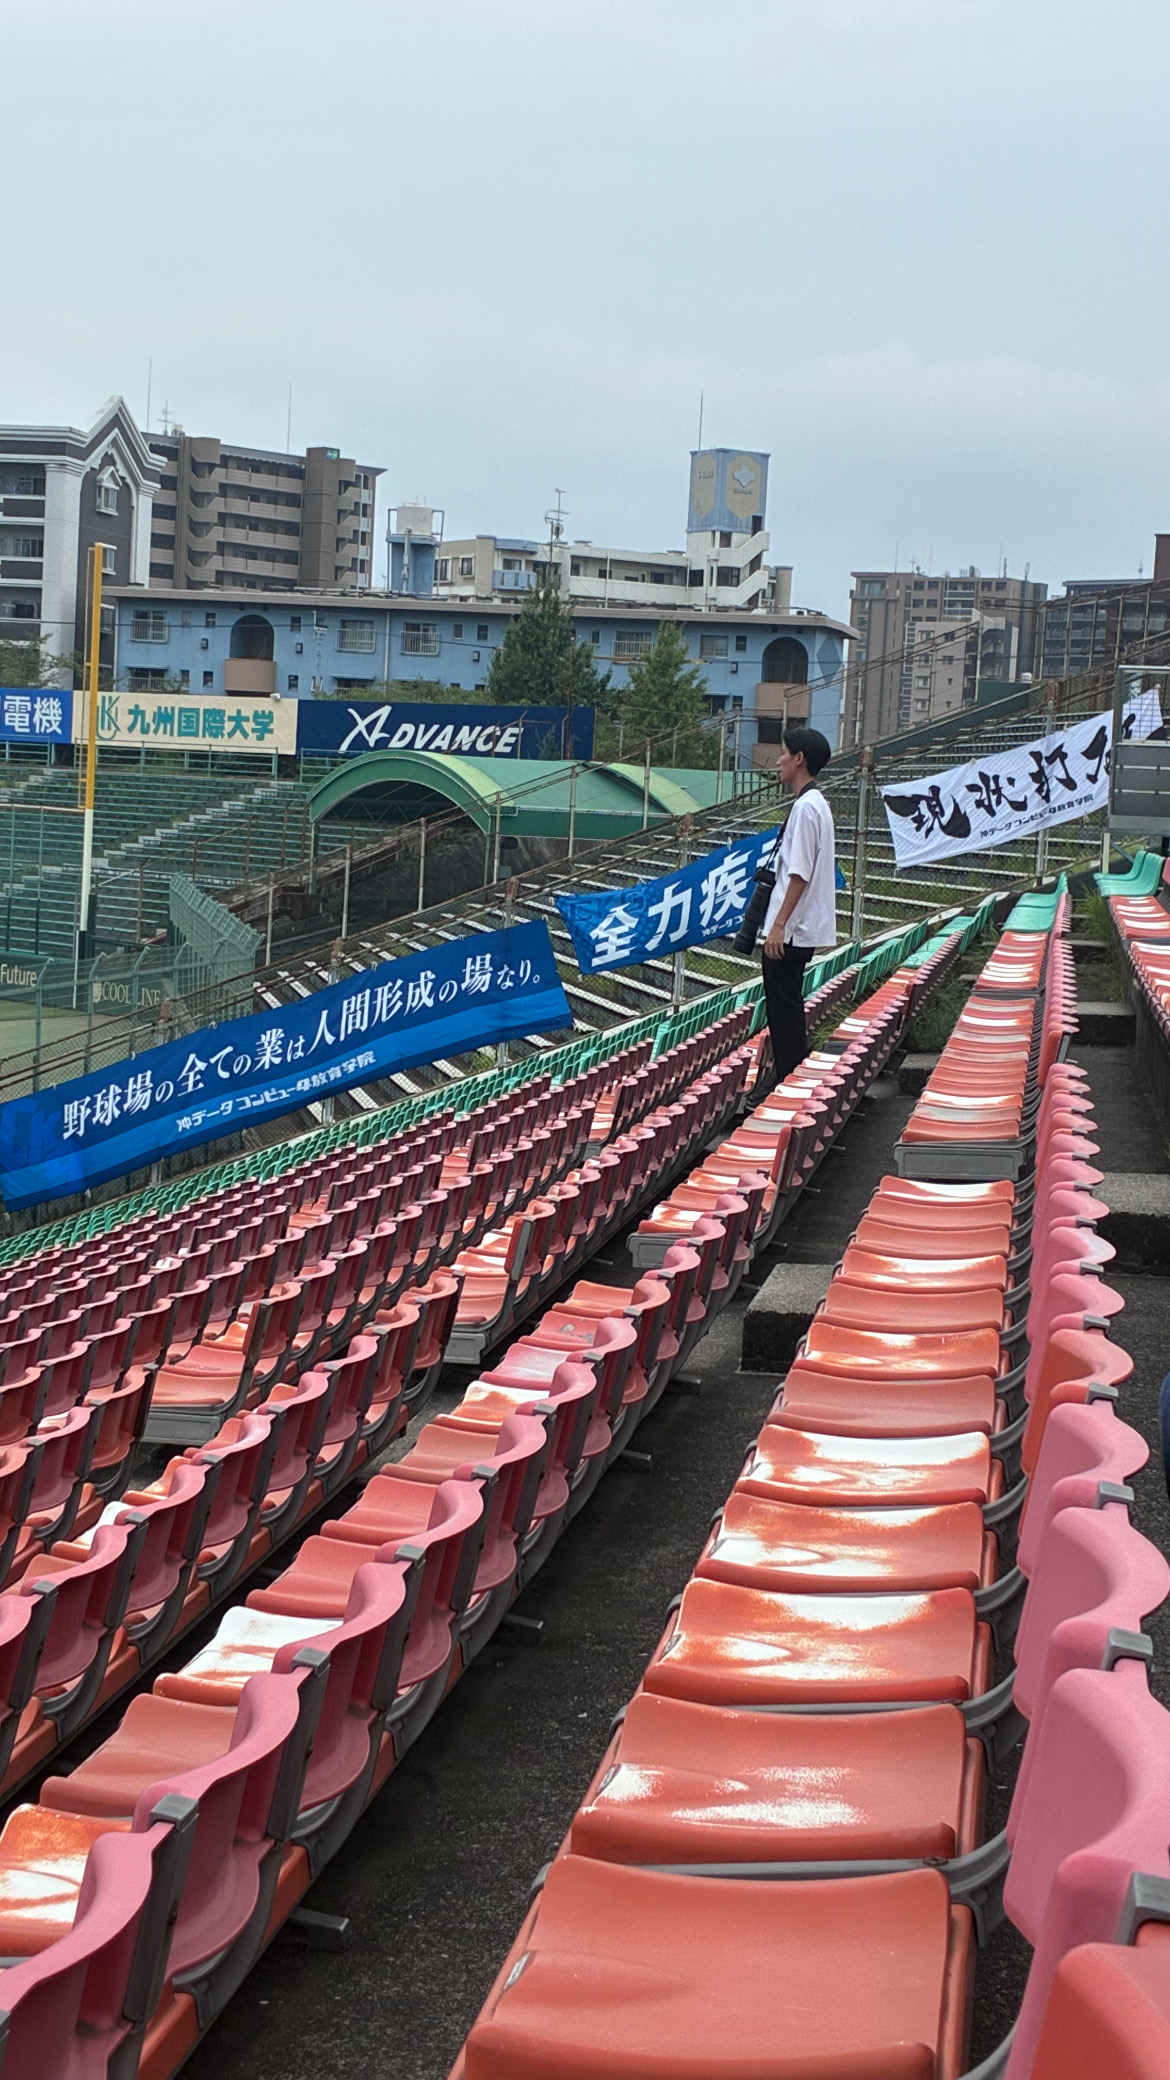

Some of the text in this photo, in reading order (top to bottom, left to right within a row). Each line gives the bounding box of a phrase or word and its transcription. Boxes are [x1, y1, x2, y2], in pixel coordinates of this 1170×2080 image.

[0, 694, 63, 735] 電機
[127, 704, 275, 741] 九州国際大学
[701, 913, 746, 937] 沖データコ
